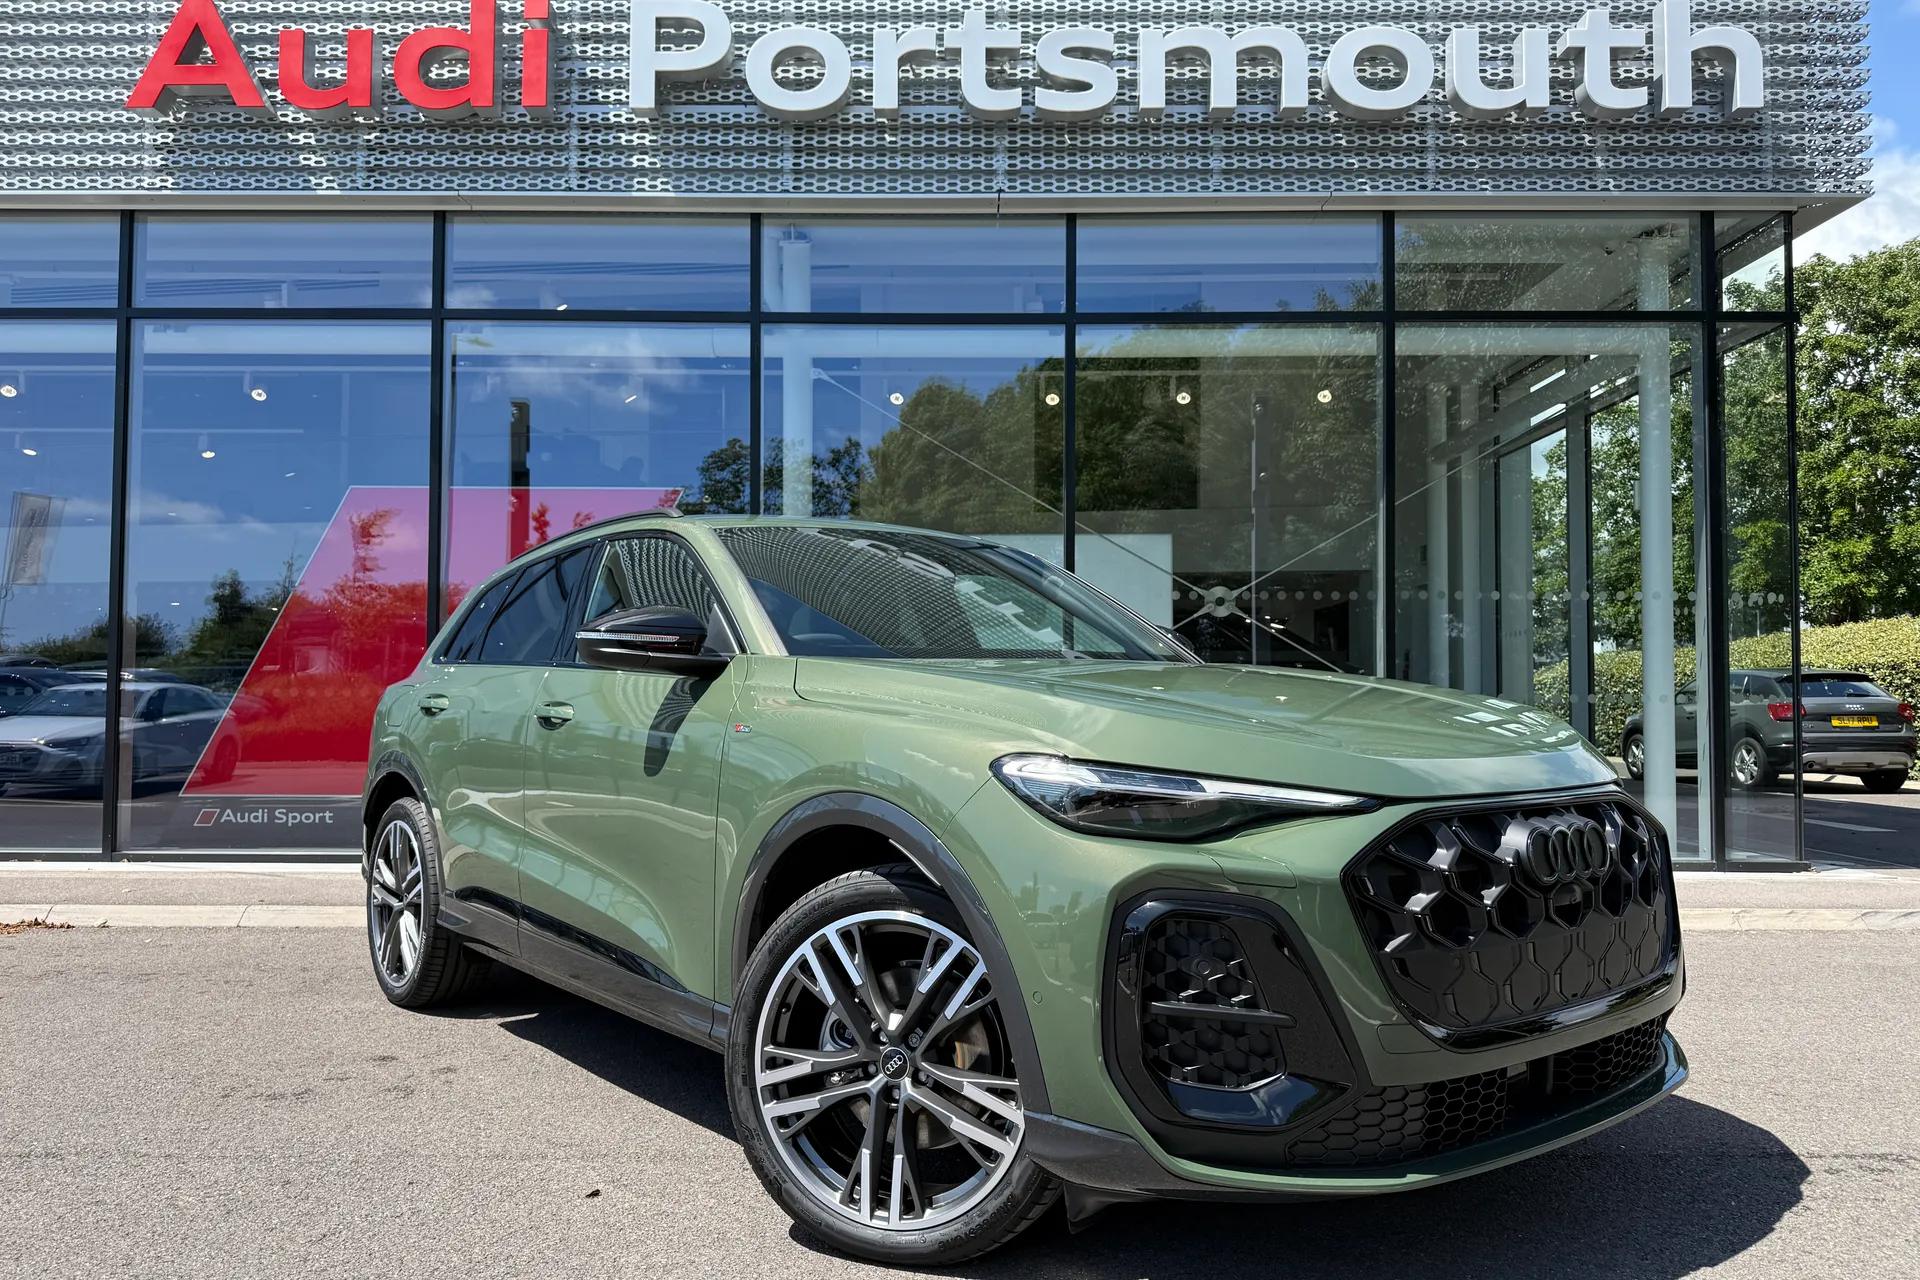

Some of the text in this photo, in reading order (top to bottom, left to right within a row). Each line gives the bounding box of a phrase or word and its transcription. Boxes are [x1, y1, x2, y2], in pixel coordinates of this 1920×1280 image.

[126, 0, 1764, 115] Audi Portsmouth
[1837, 716, 1873, 725] SL17 RPU
[220, 808, 334, 827] Audi Sport
